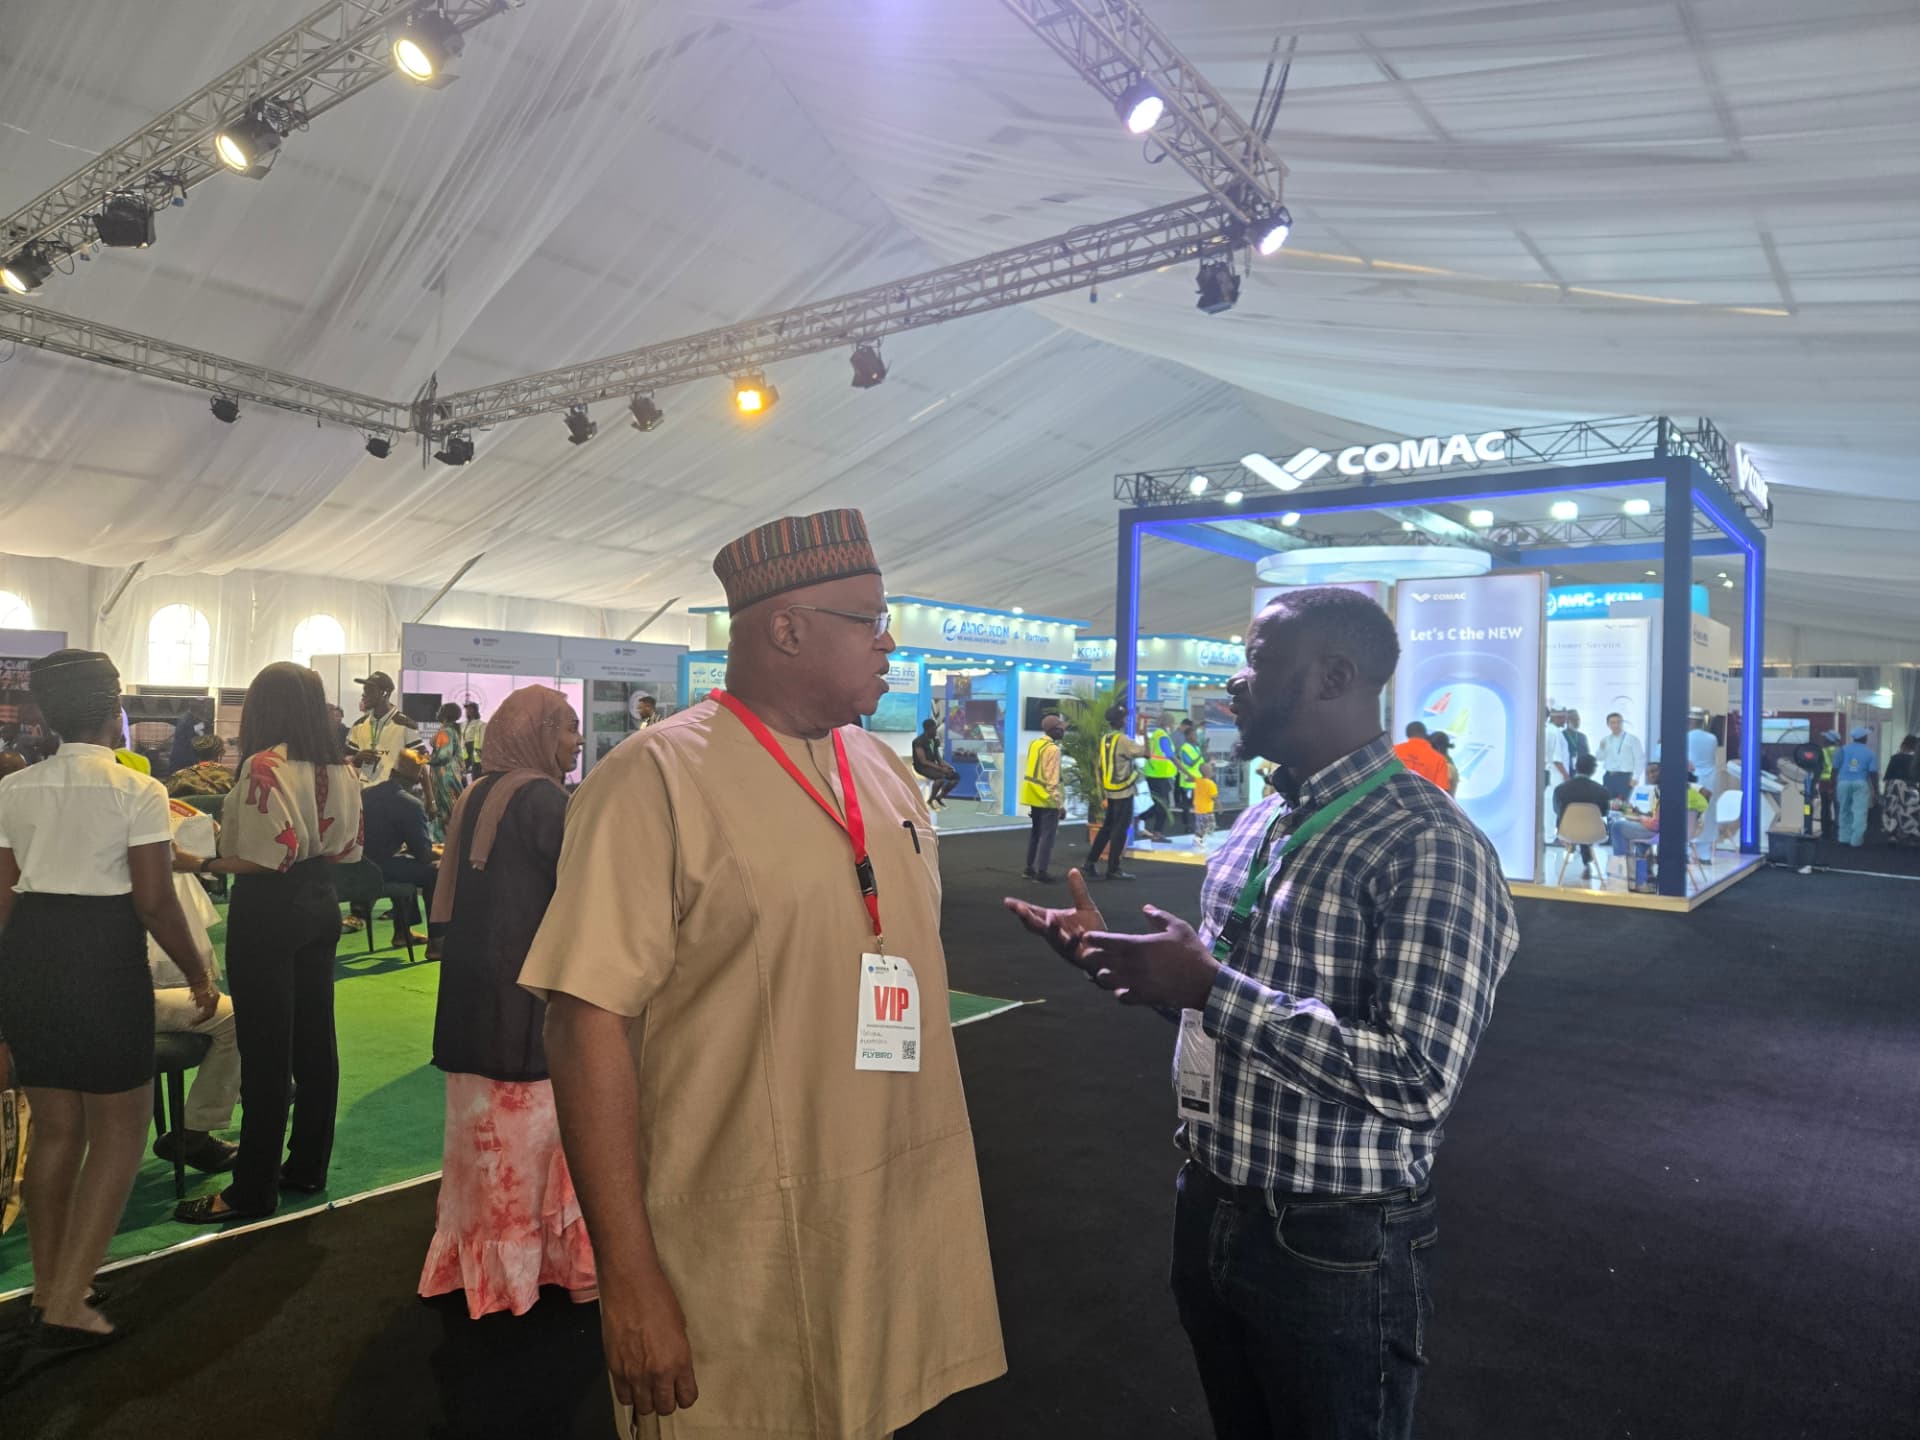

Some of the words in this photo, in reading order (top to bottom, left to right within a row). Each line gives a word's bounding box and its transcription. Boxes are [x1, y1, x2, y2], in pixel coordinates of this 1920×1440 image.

[1337, 431, 1506, 475] COMAC
[1432, 592, 1467, 601] COMAC
[1410, 627, 1445, 641] Let's
[1447, 628, 1457, 641] C
[1459, 626, 1485, 641] the
[1488, 626, 1522, 640] NEW
[873, 985, 909, 1022] VIP
[862, 1051, 893, 1060] FLYBIRD
